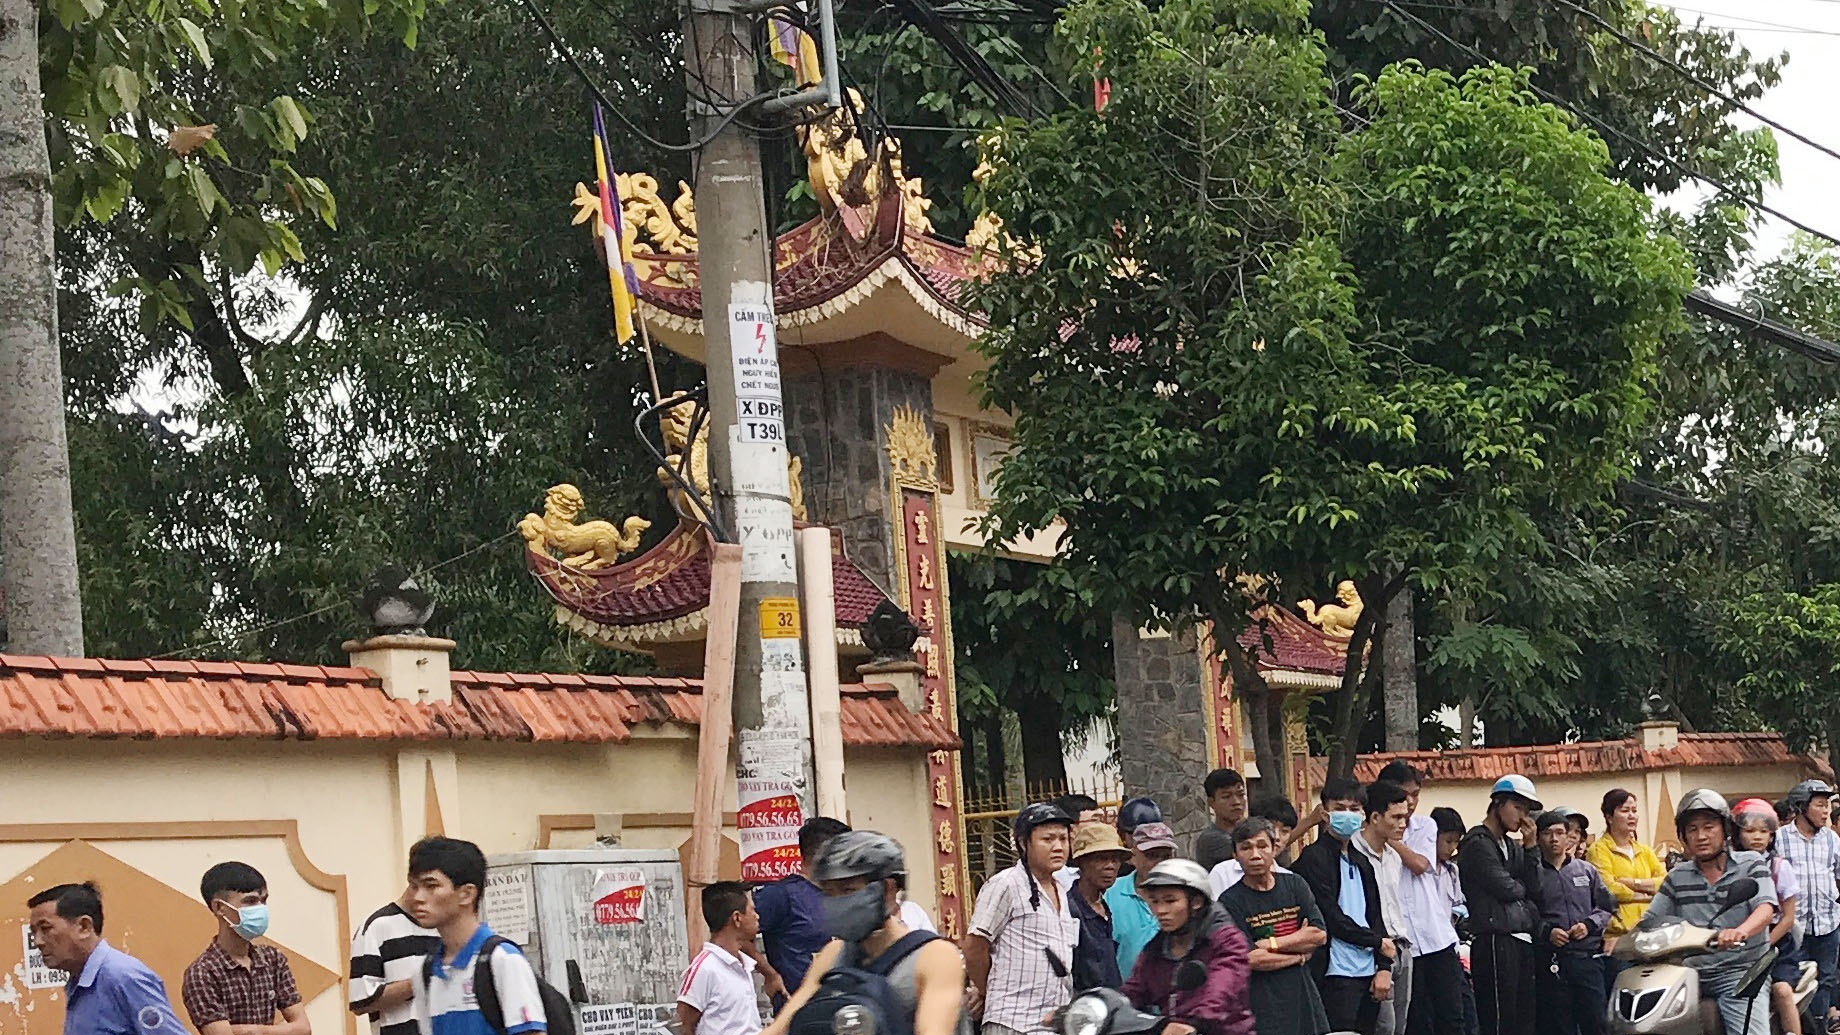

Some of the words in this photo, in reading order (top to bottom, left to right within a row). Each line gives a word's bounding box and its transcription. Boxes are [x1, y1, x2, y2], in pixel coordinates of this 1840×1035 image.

[742, 400, 753, 415] X
[777, 612, 794, 627] 32
[581, 1010, 598, 1024] CHO
[599, 1008, 614, 1022] VAY
